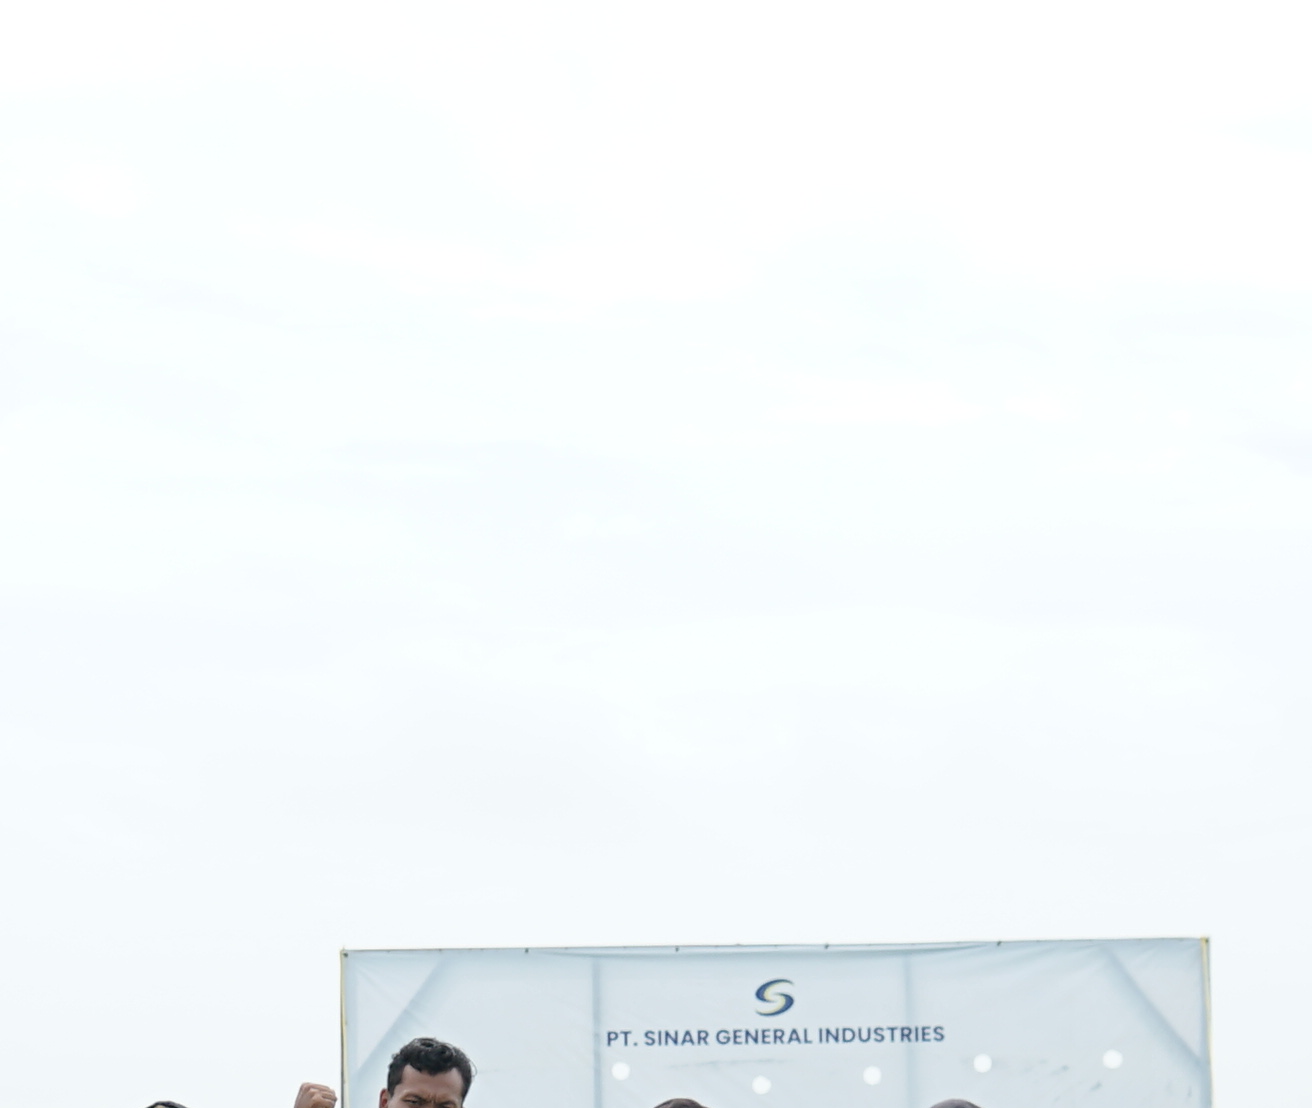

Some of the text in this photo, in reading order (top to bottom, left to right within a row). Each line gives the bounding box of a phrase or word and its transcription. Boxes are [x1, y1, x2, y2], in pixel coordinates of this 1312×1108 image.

[607, 1025, 945, 1047] PT. SINAR GENERAL INDUSTRIES
